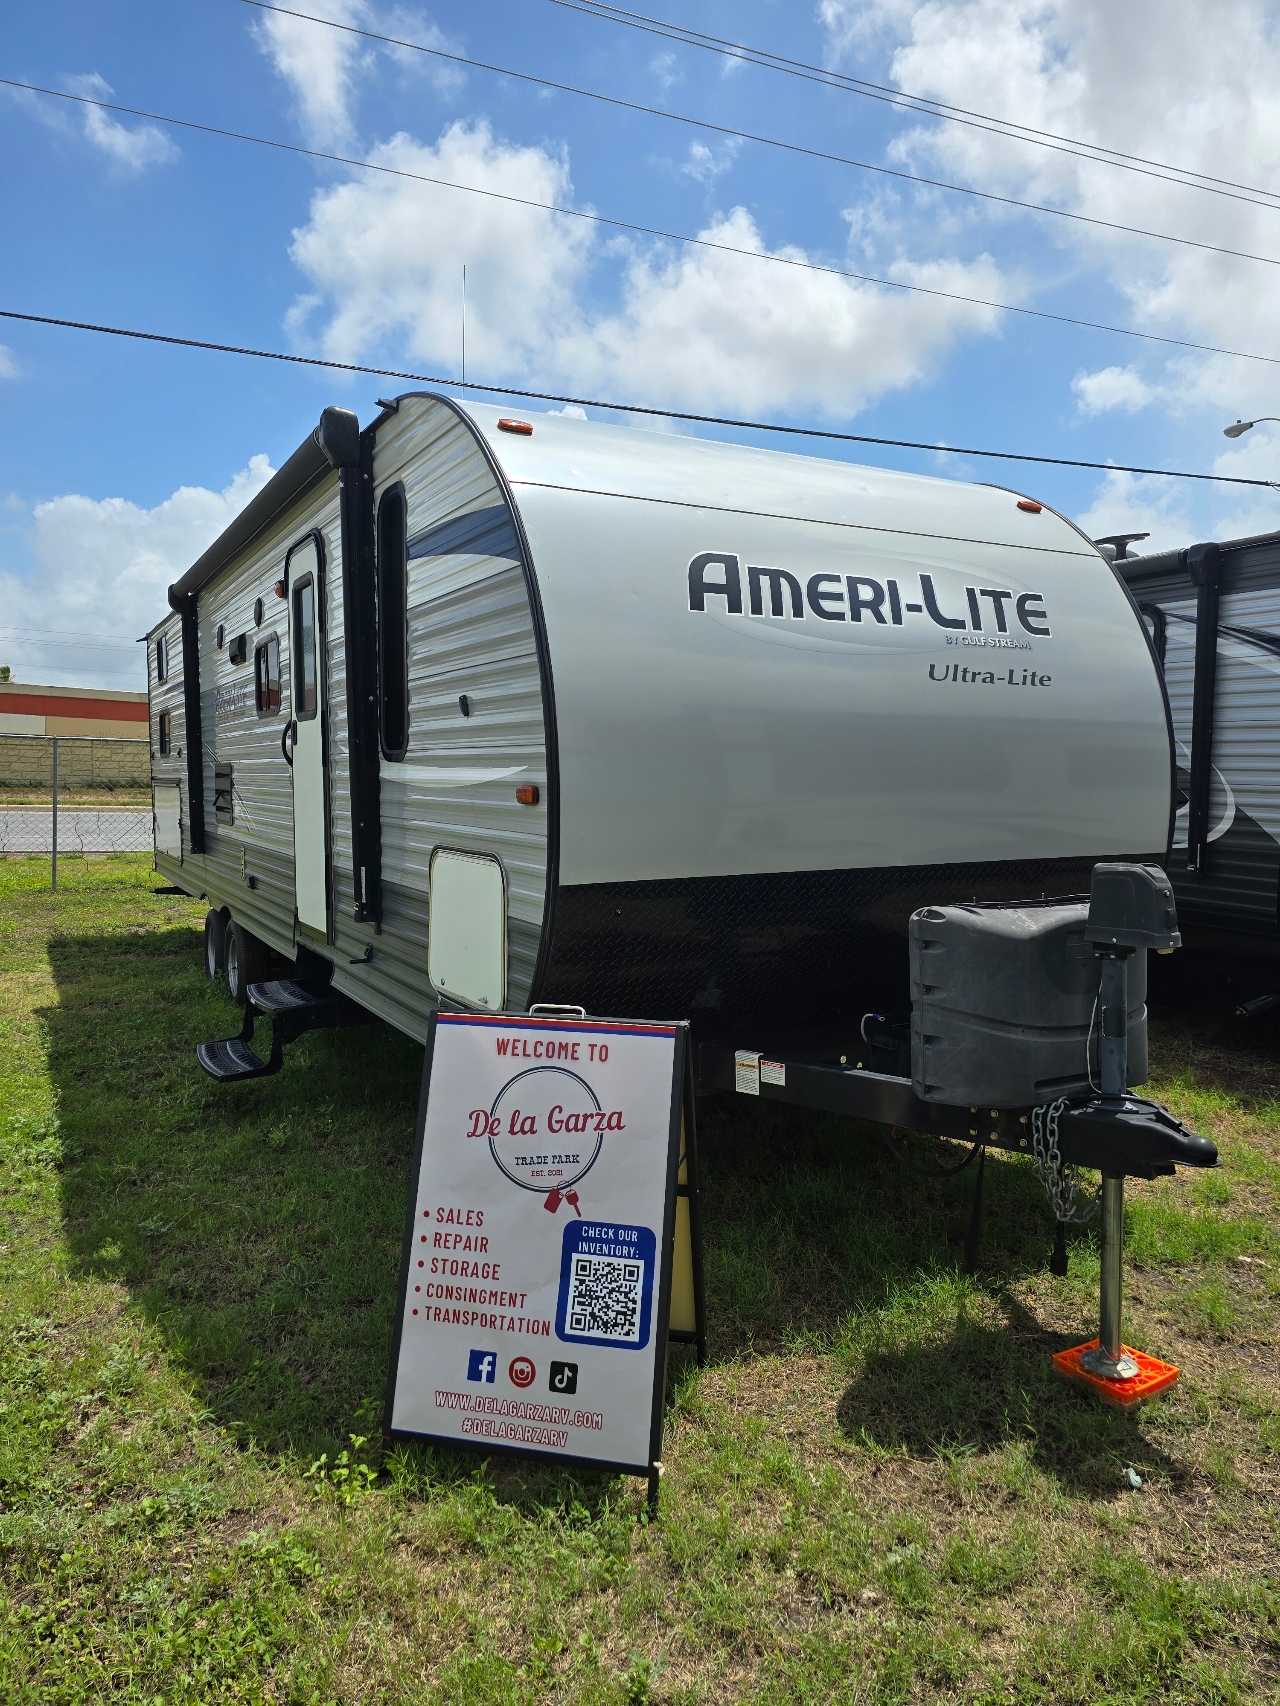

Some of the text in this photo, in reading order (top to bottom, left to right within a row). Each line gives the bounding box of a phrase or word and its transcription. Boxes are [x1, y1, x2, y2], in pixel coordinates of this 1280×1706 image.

[687, 551, 1053, 638] AMERI-LITE
[945, 635, 1033, 650] BY GULF STREAM
[928, 663, 1053, 687] Ultra-Lite
[496, 1037, 610, 1063] WELCOME TO
[466, 1104, 627, 1138] De la Garza
[514, 1154, 580, 1166] TRADE PARK
[435, 1207, 484, 1227] SALES
[433, 1232, 489, 1253] REPAIR
[581, 1226, 638, 1242] CHECK OUR
[578, 1241, 640, 1258] INVENTORY:
[430, 1257, 501, 1281] STORAGE
[426, 1283, 528, 1309] CONSINGMENT
[424, 1306, 551, 1337] TRANSPORTATION
[434, 1390, 603, 1430] WWW.DELAGARZARV.COM
[462, 1417, 568, 1447] #DELAGARZARV
